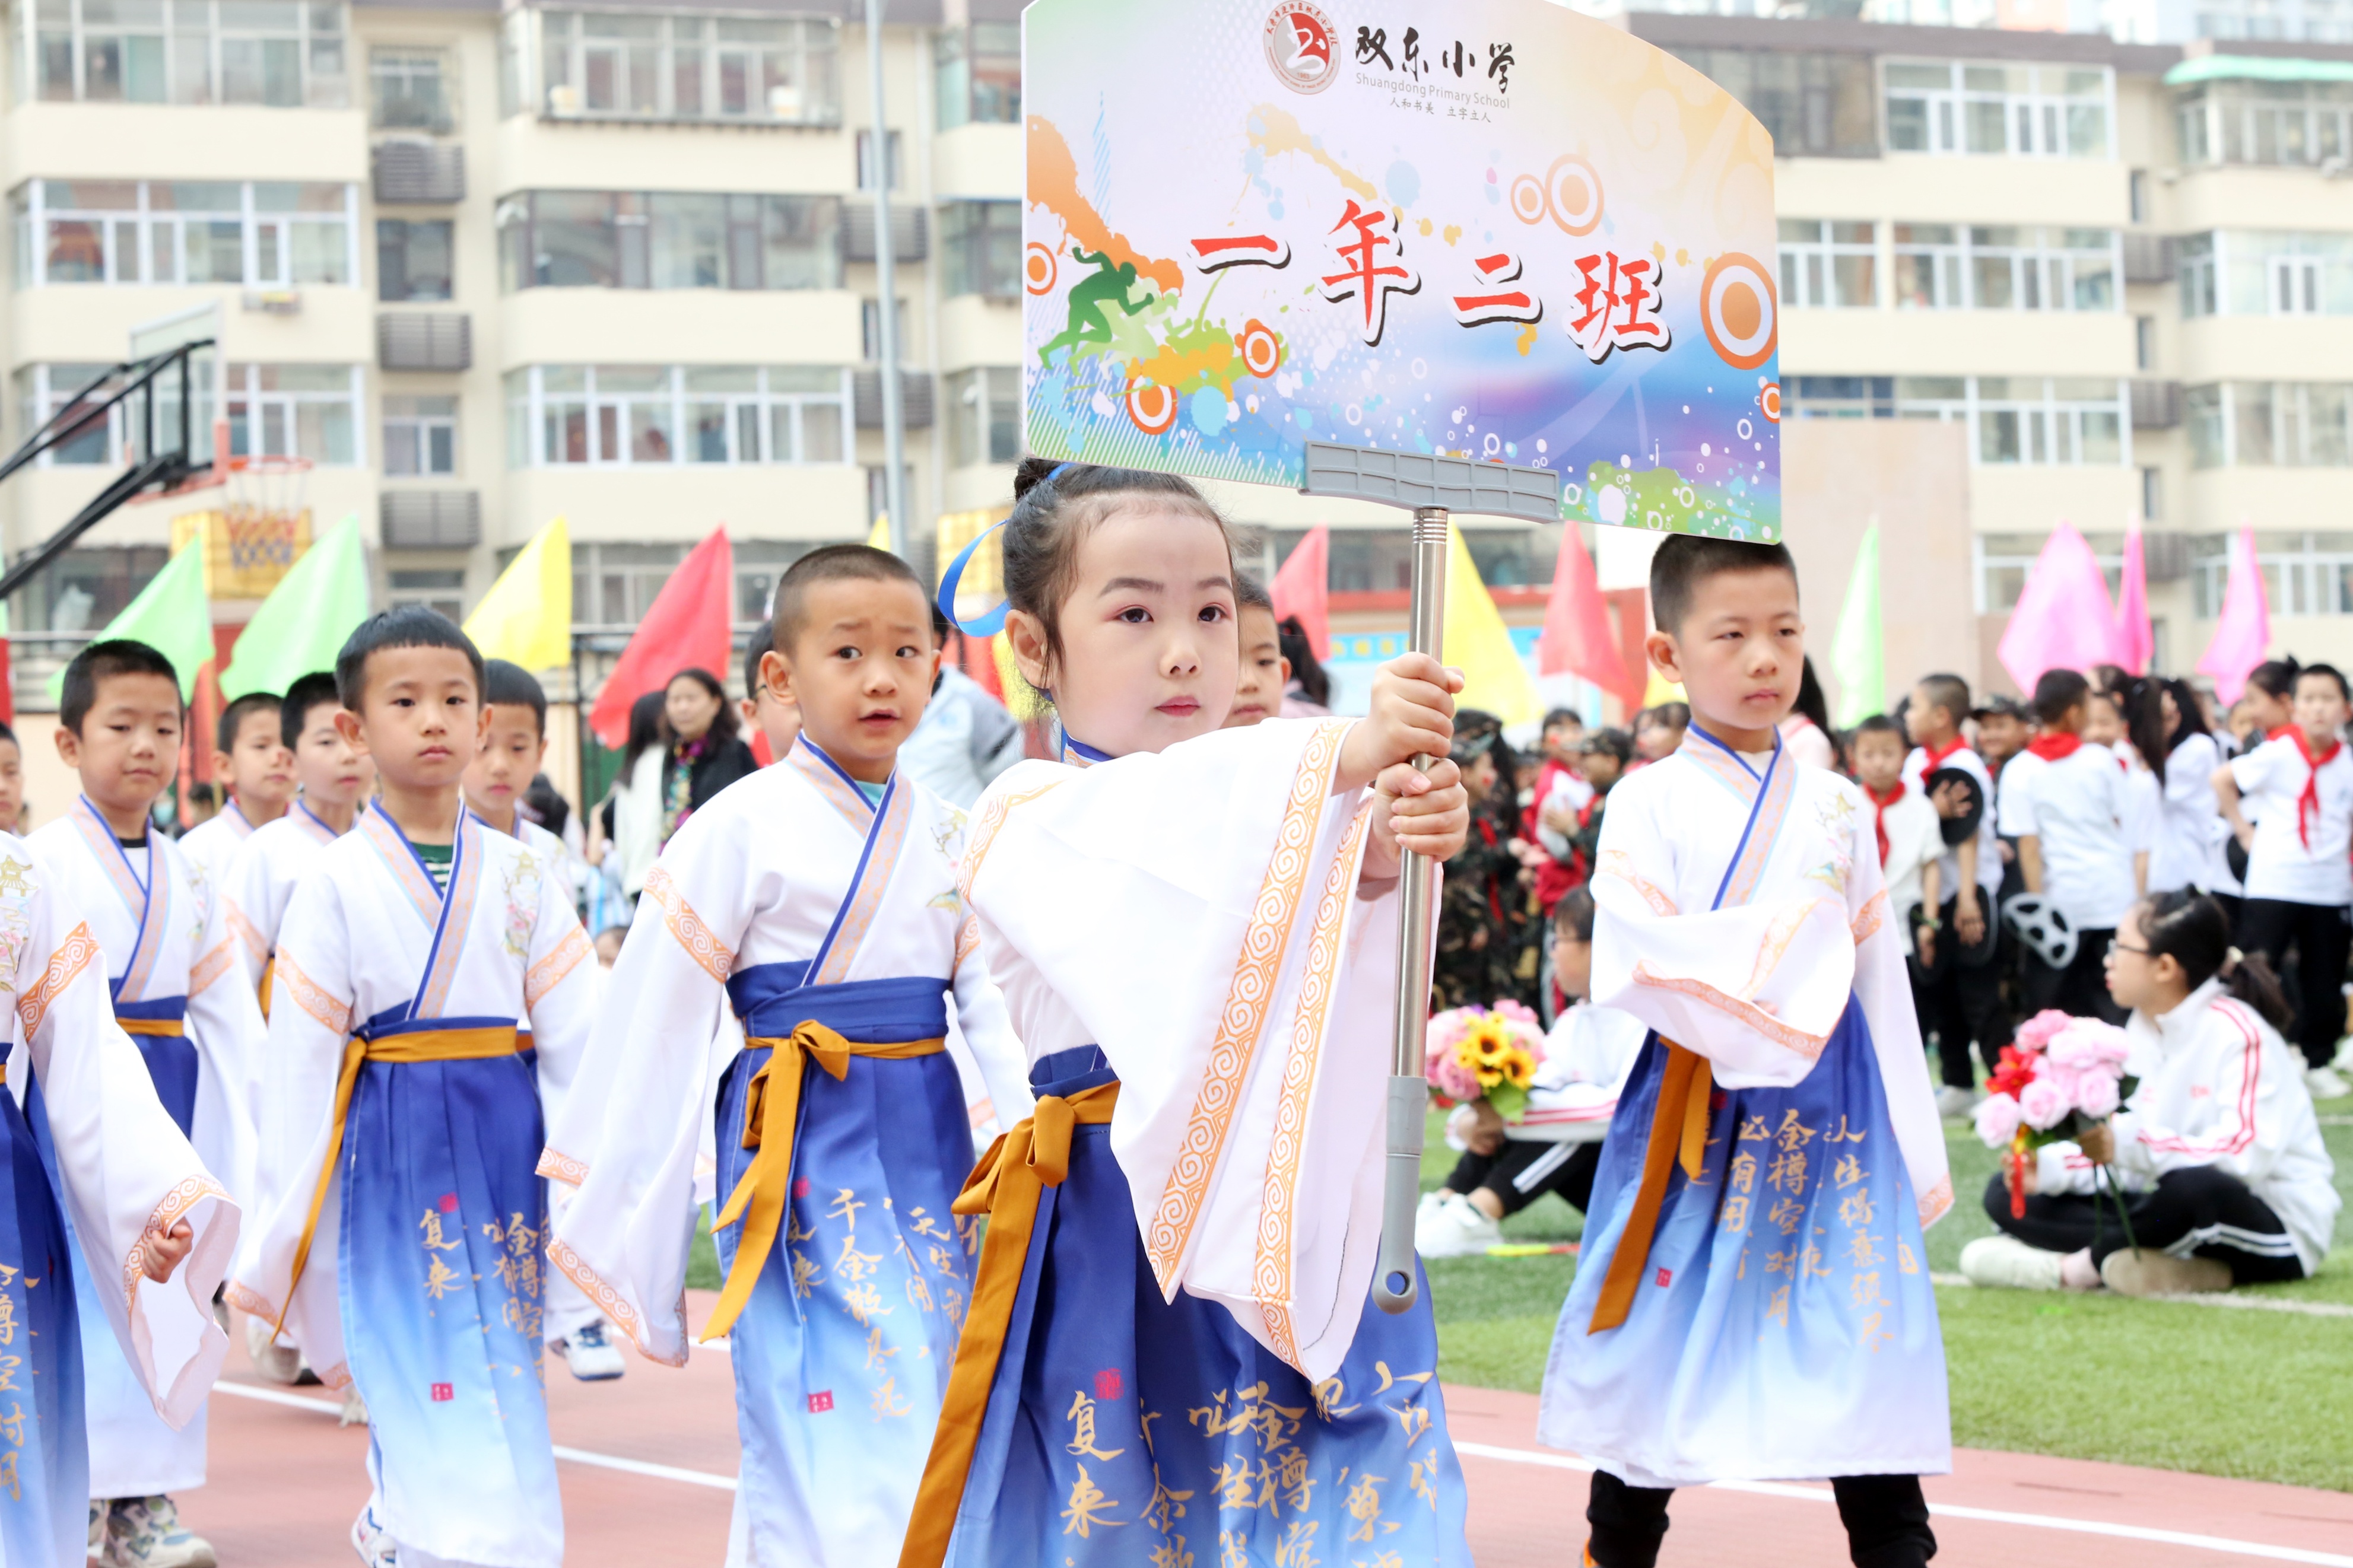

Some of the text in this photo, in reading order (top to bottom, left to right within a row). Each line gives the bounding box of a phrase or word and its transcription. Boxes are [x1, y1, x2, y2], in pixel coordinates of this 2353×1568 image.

[1355, 26, 1515, 94] 双东小学
[1356, 72, 1510, 109] Shuangdong Primary School
[1190, 199, 1671, 364] 一年二班
[1060, 1389, 1129, 1540] 复来
